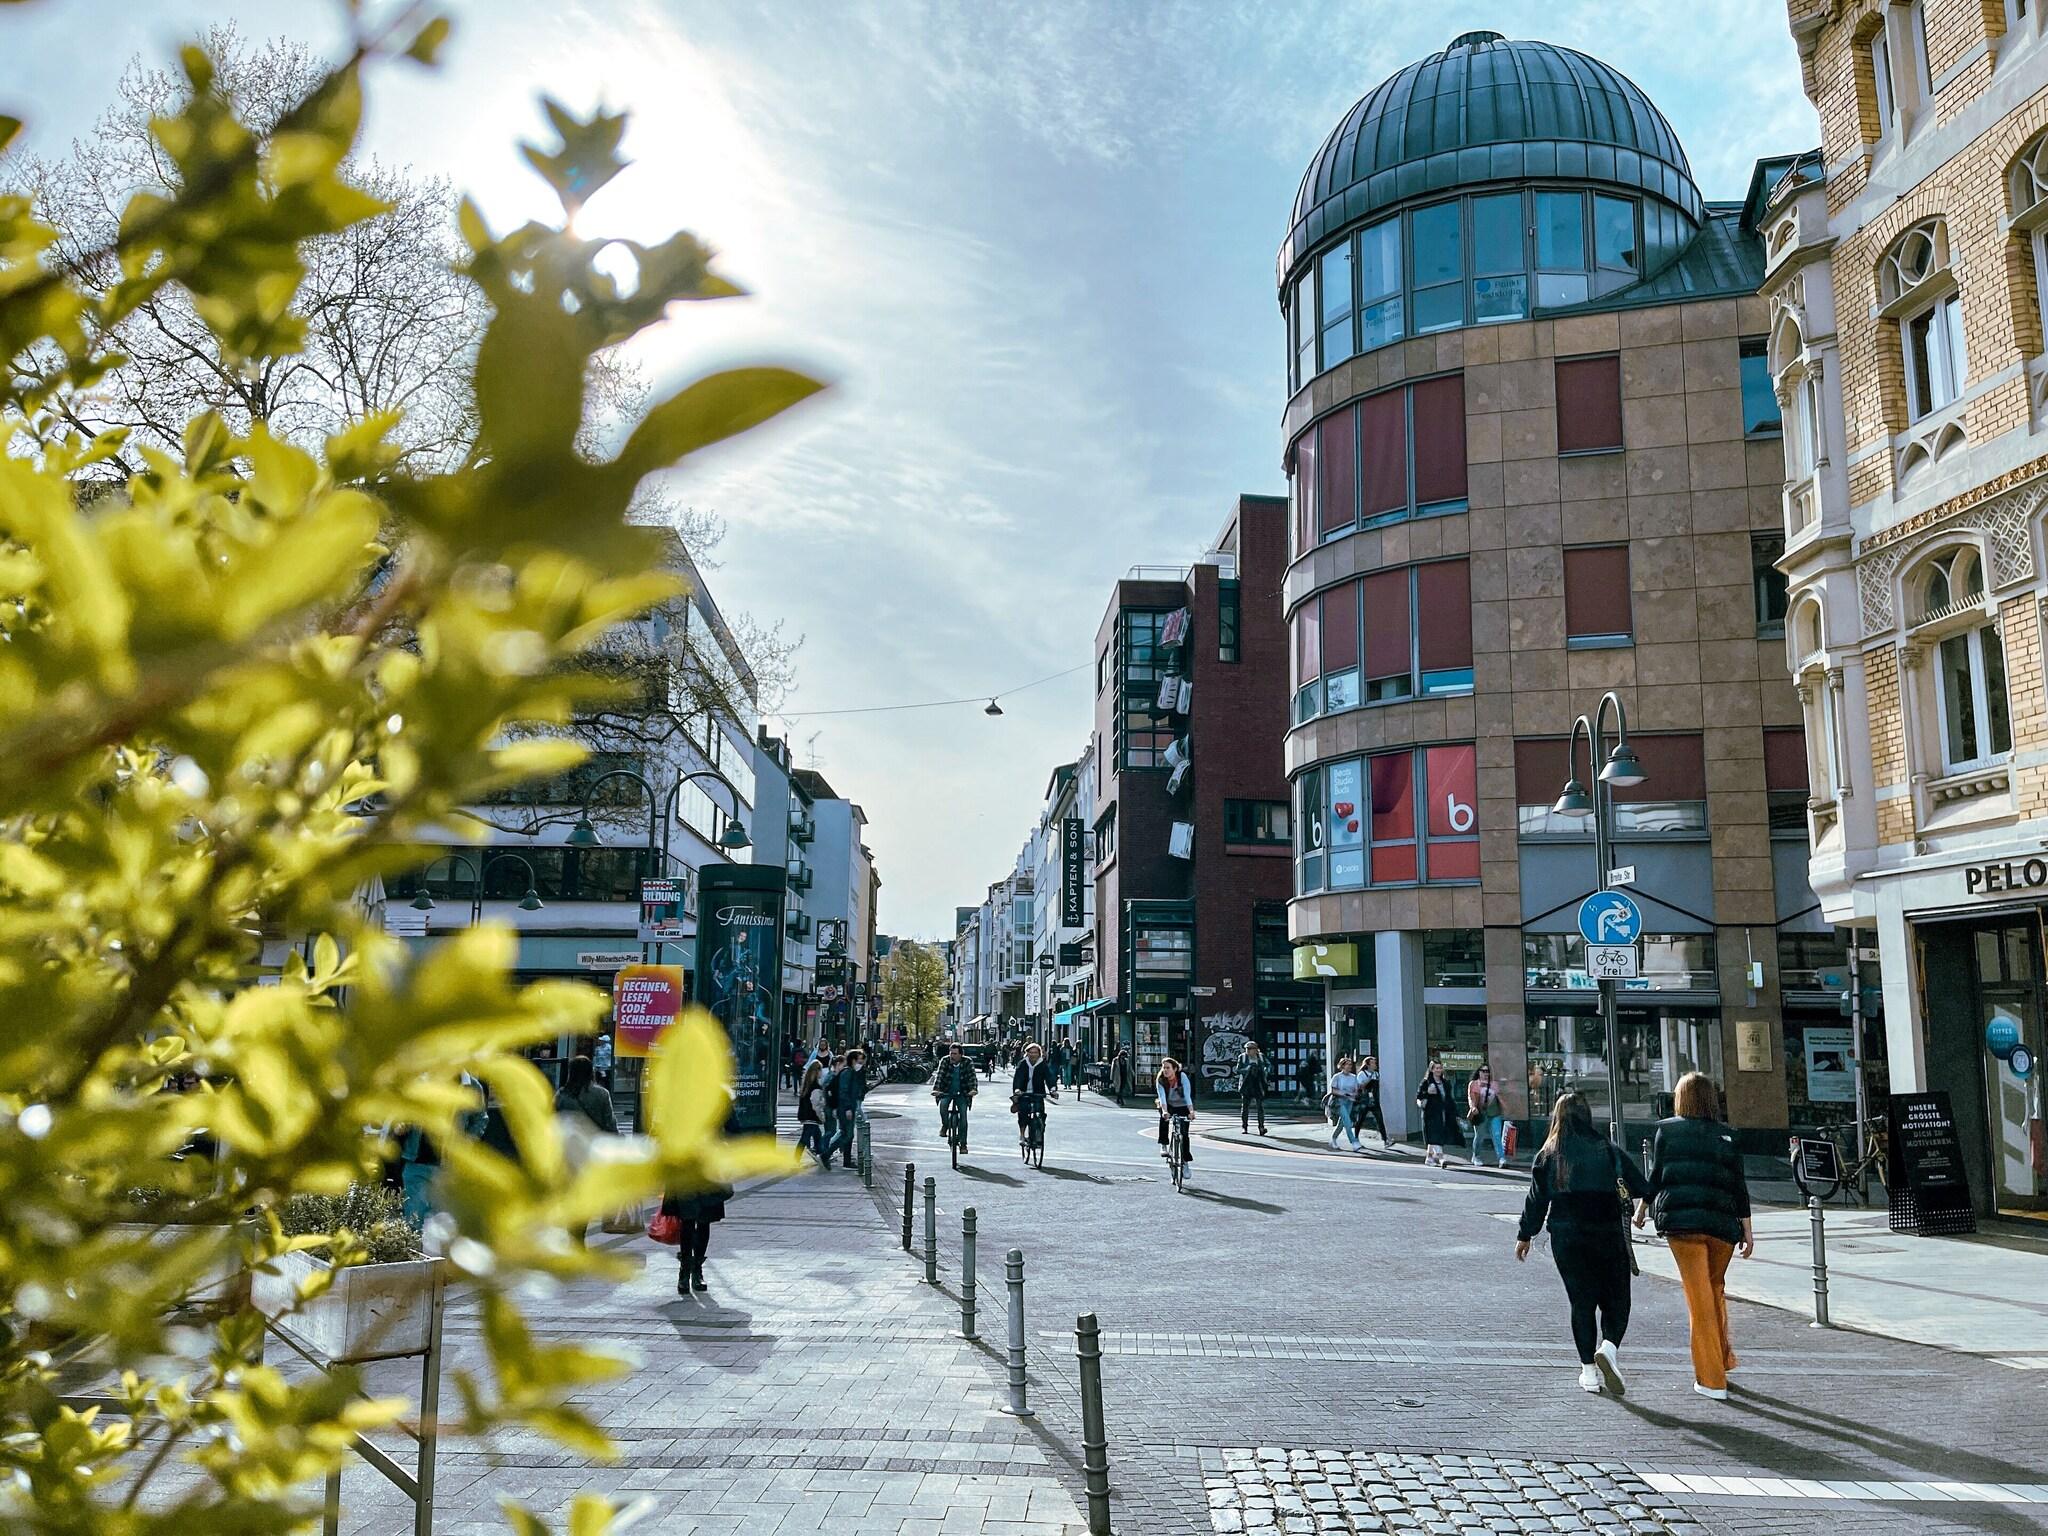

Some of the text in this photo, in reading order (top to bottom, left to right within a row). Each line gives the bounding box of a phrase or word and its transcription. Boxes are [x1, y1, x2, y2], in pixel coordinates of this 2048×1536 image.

[1069, 822, 1077, 912] KAPTEN & SON
[1965, 858, 2047, 895] PELO
[642, 891, 681, 902] BILDUNG
[715, 905, 775, 926] Fantissima
[1603, 966, 1622, 975] frei
[622, 981, 671, 994] RECHNEN,
[621, 992, 653, 1005] LESEN,
[620, 1003, 647, 1014] CODE
[620, 1014, 676, 1025] SCHREIBEN.
